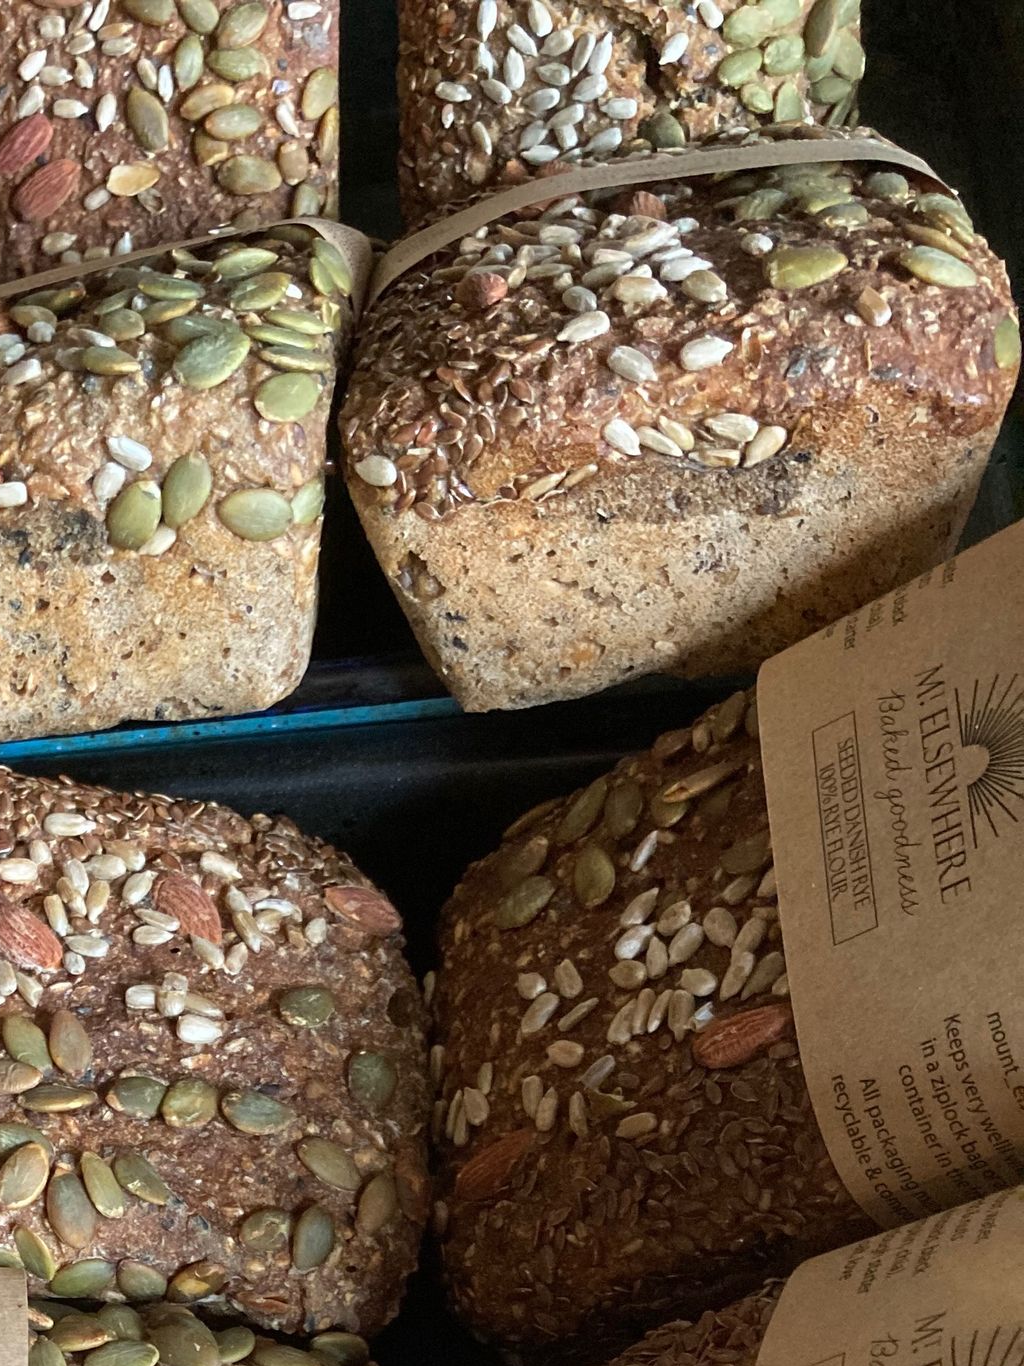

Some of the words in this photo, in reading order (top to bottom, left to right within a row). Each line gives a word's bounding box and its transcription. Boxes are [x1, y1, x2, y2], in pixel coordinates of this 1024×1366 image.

[877, 690, 912, 780] Baked
[820, 762, 839, 803] 100%
[837, 737, 857, 802] SEEDED
[823, 806, 842, 840] RYE
[919, 708, 971, 904] ELSEWHERE
[827, 840, 847, 902] FLOUR
[843, 808, 864, 874] DANISH
[874, 789, 922, 916] goodness
[852, 878, 872, 911] RYE
[920, 1039, 936, 1058] in
[925, 1062, 940, 1073] a
[944, 1014, 969, 1071] Keeps
[961, 1073, 987, 1114] very
[860, 1078, 880, 1101] All
[899, 1064, 943, 1149] container
[934, 1152, 953, 1168] in
[931, 1076, 969, 1141] ziplock
[832, 1074, 872, 1165] recyclable
[865, 1167, 882, 1181] &
[863, 1105, 920, 1193] packaging
[961, 1141, 987, 1170] bag
